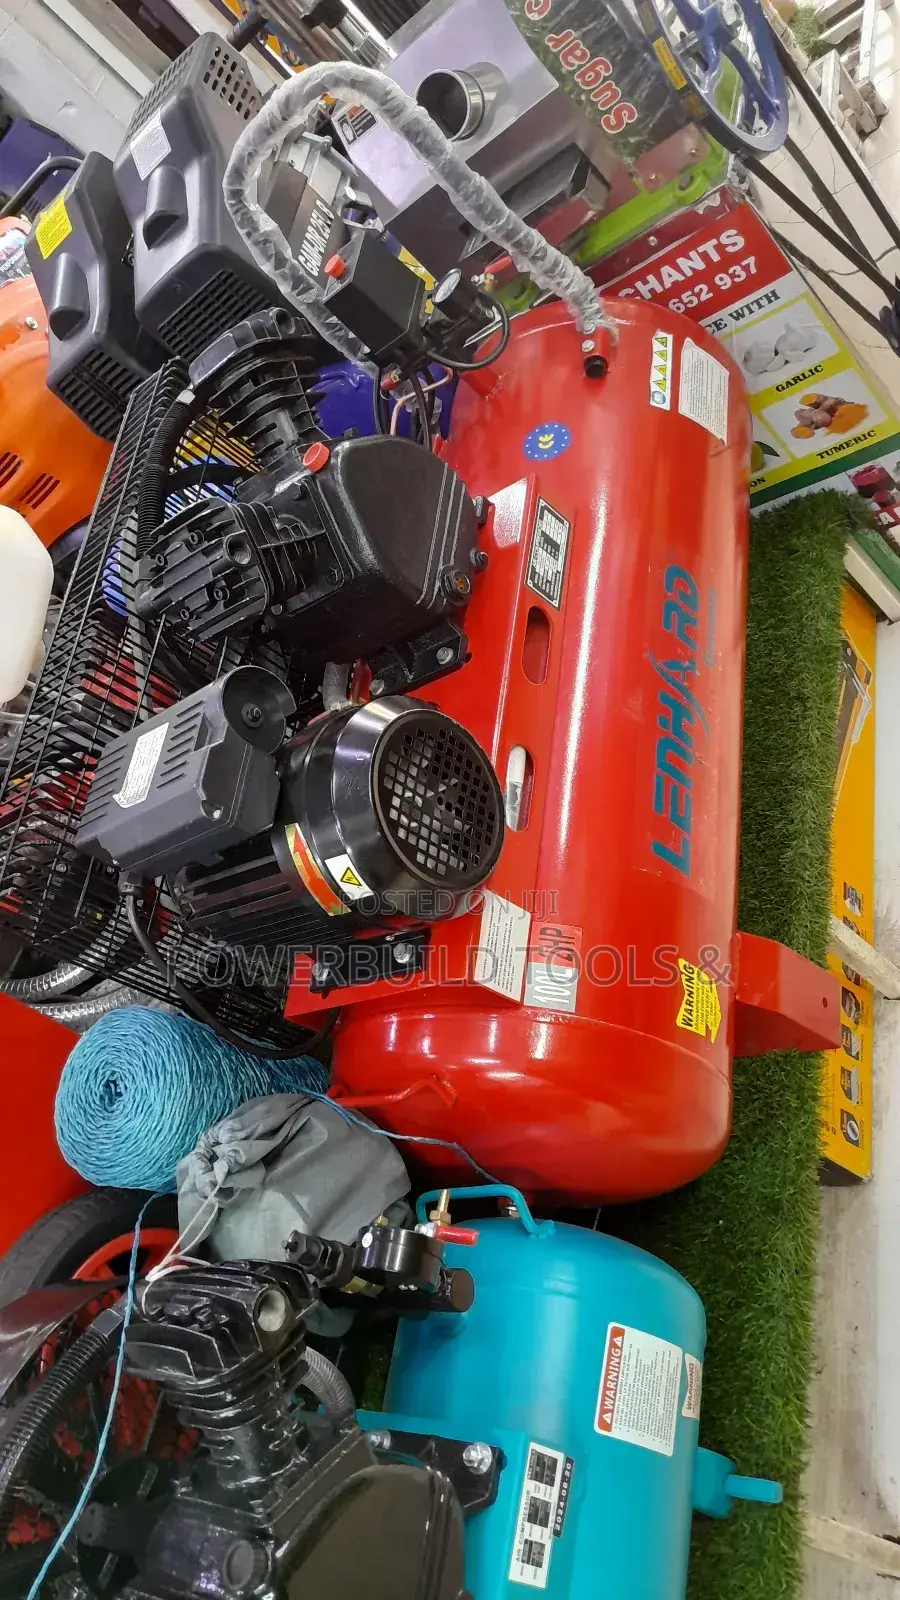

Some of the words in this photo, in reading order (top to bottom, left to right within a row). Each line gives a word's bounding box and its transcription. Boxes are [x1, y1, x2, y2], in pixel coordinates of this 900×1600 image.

[545, 28, 638, 134] Sugar
[668, 283, 714, 314] 652
[714, 255, 758, 291] 937
[729, 288, 781, 323] WITH
[775, 364, 824, 394] GARLIC
[816, 429, 877, 460] TUMERIC
[532, 968, 574, 1004] 100L
[681, 963, 695, 1028] WARNING
[603, 1347, 622, 1412] WARNING
[687, 1362, 695, 1410] WARNING
[519, 1490, 531, 1545] COMPRESSOR
